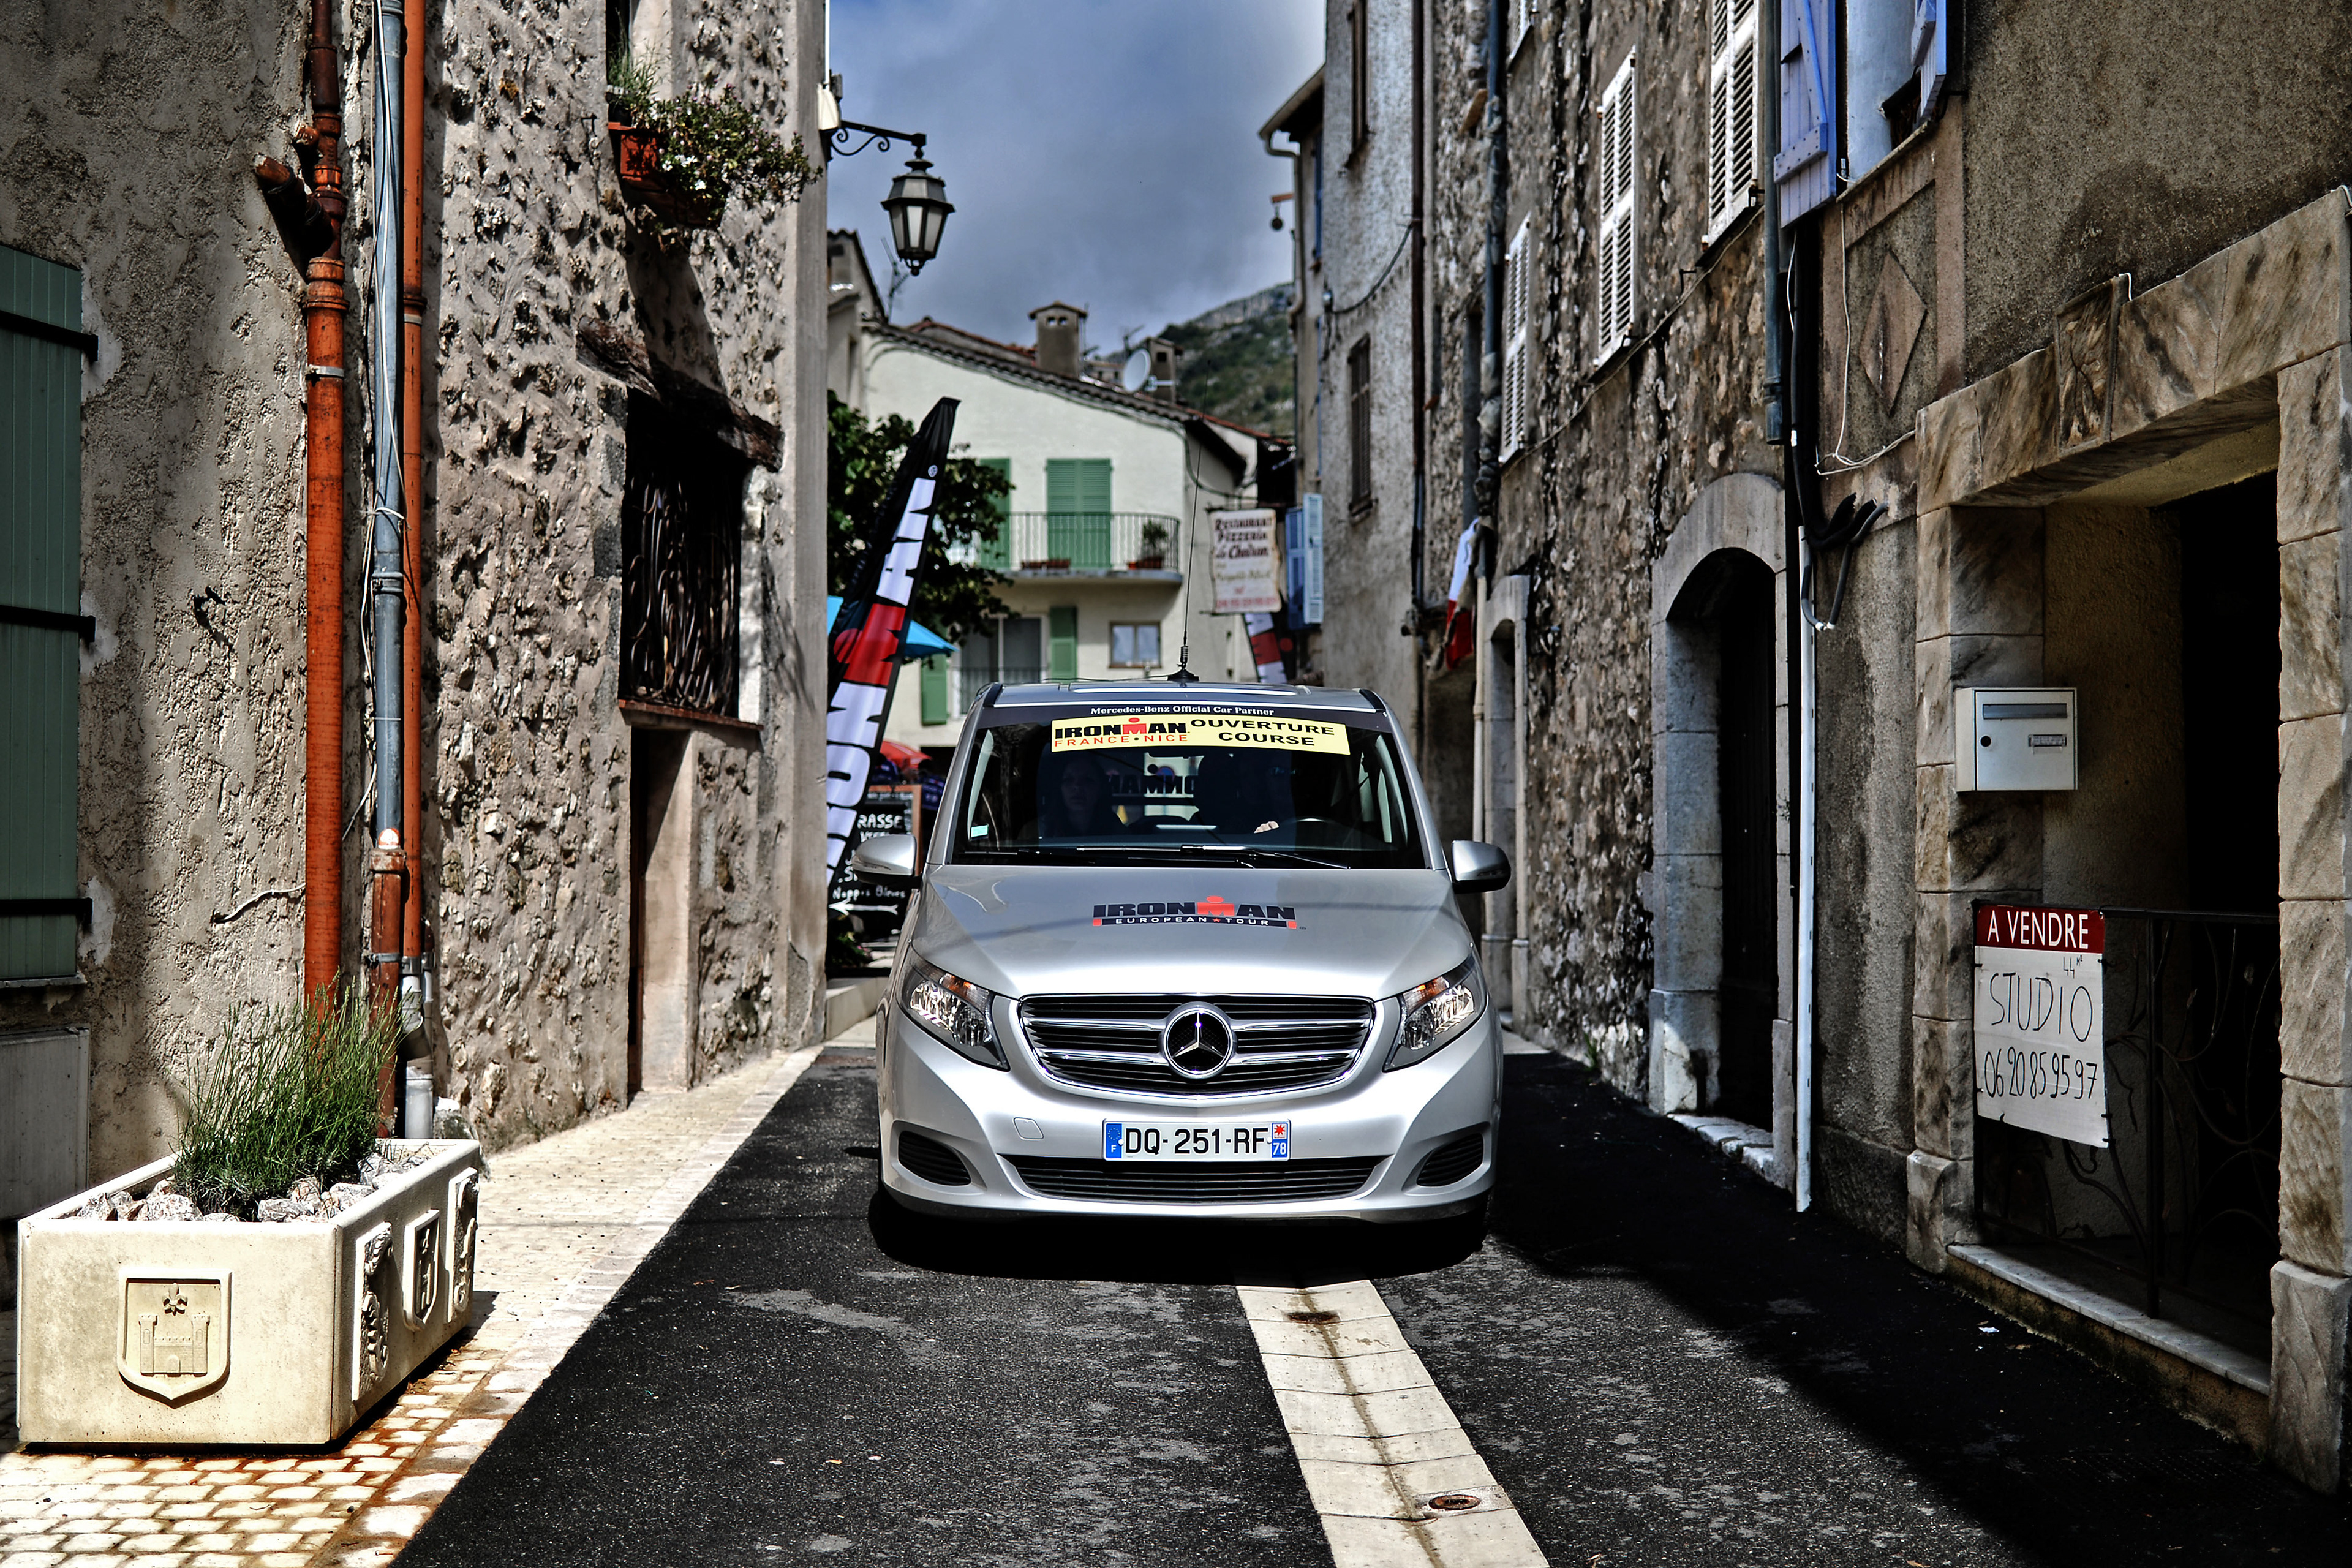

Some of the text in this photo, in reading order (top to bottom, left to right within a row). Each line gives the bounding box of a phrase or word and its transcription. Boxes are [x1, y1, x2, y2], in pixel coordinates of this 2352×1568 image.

[827, 477, 935, 888] ONMAN
[1090, 706, 1170, 715] Mercedes-Benz
[1235, 707, 1275, 716] Partner
[1055, 717, 1187, 739] IRONMAN
[1190, 718, 1335, 736] OUVERTURE
[1054, 736, 1129, 747] FRANCE
[1218, 732, 1315, 746] COURSE
[858, 814, 903, 829] RASSE
[1093, 895, 1296, 920] IRONMAN
[1225, 918, 1269, 926] TOUR
[1987, 910, 2089, 949] A VENDRE
[1989, 971, 2094, 1042] STUDIO
[1125, 1128, 1268, 1155] DQ-251-RF
[1273, 1142, 1287, 1155] 78
